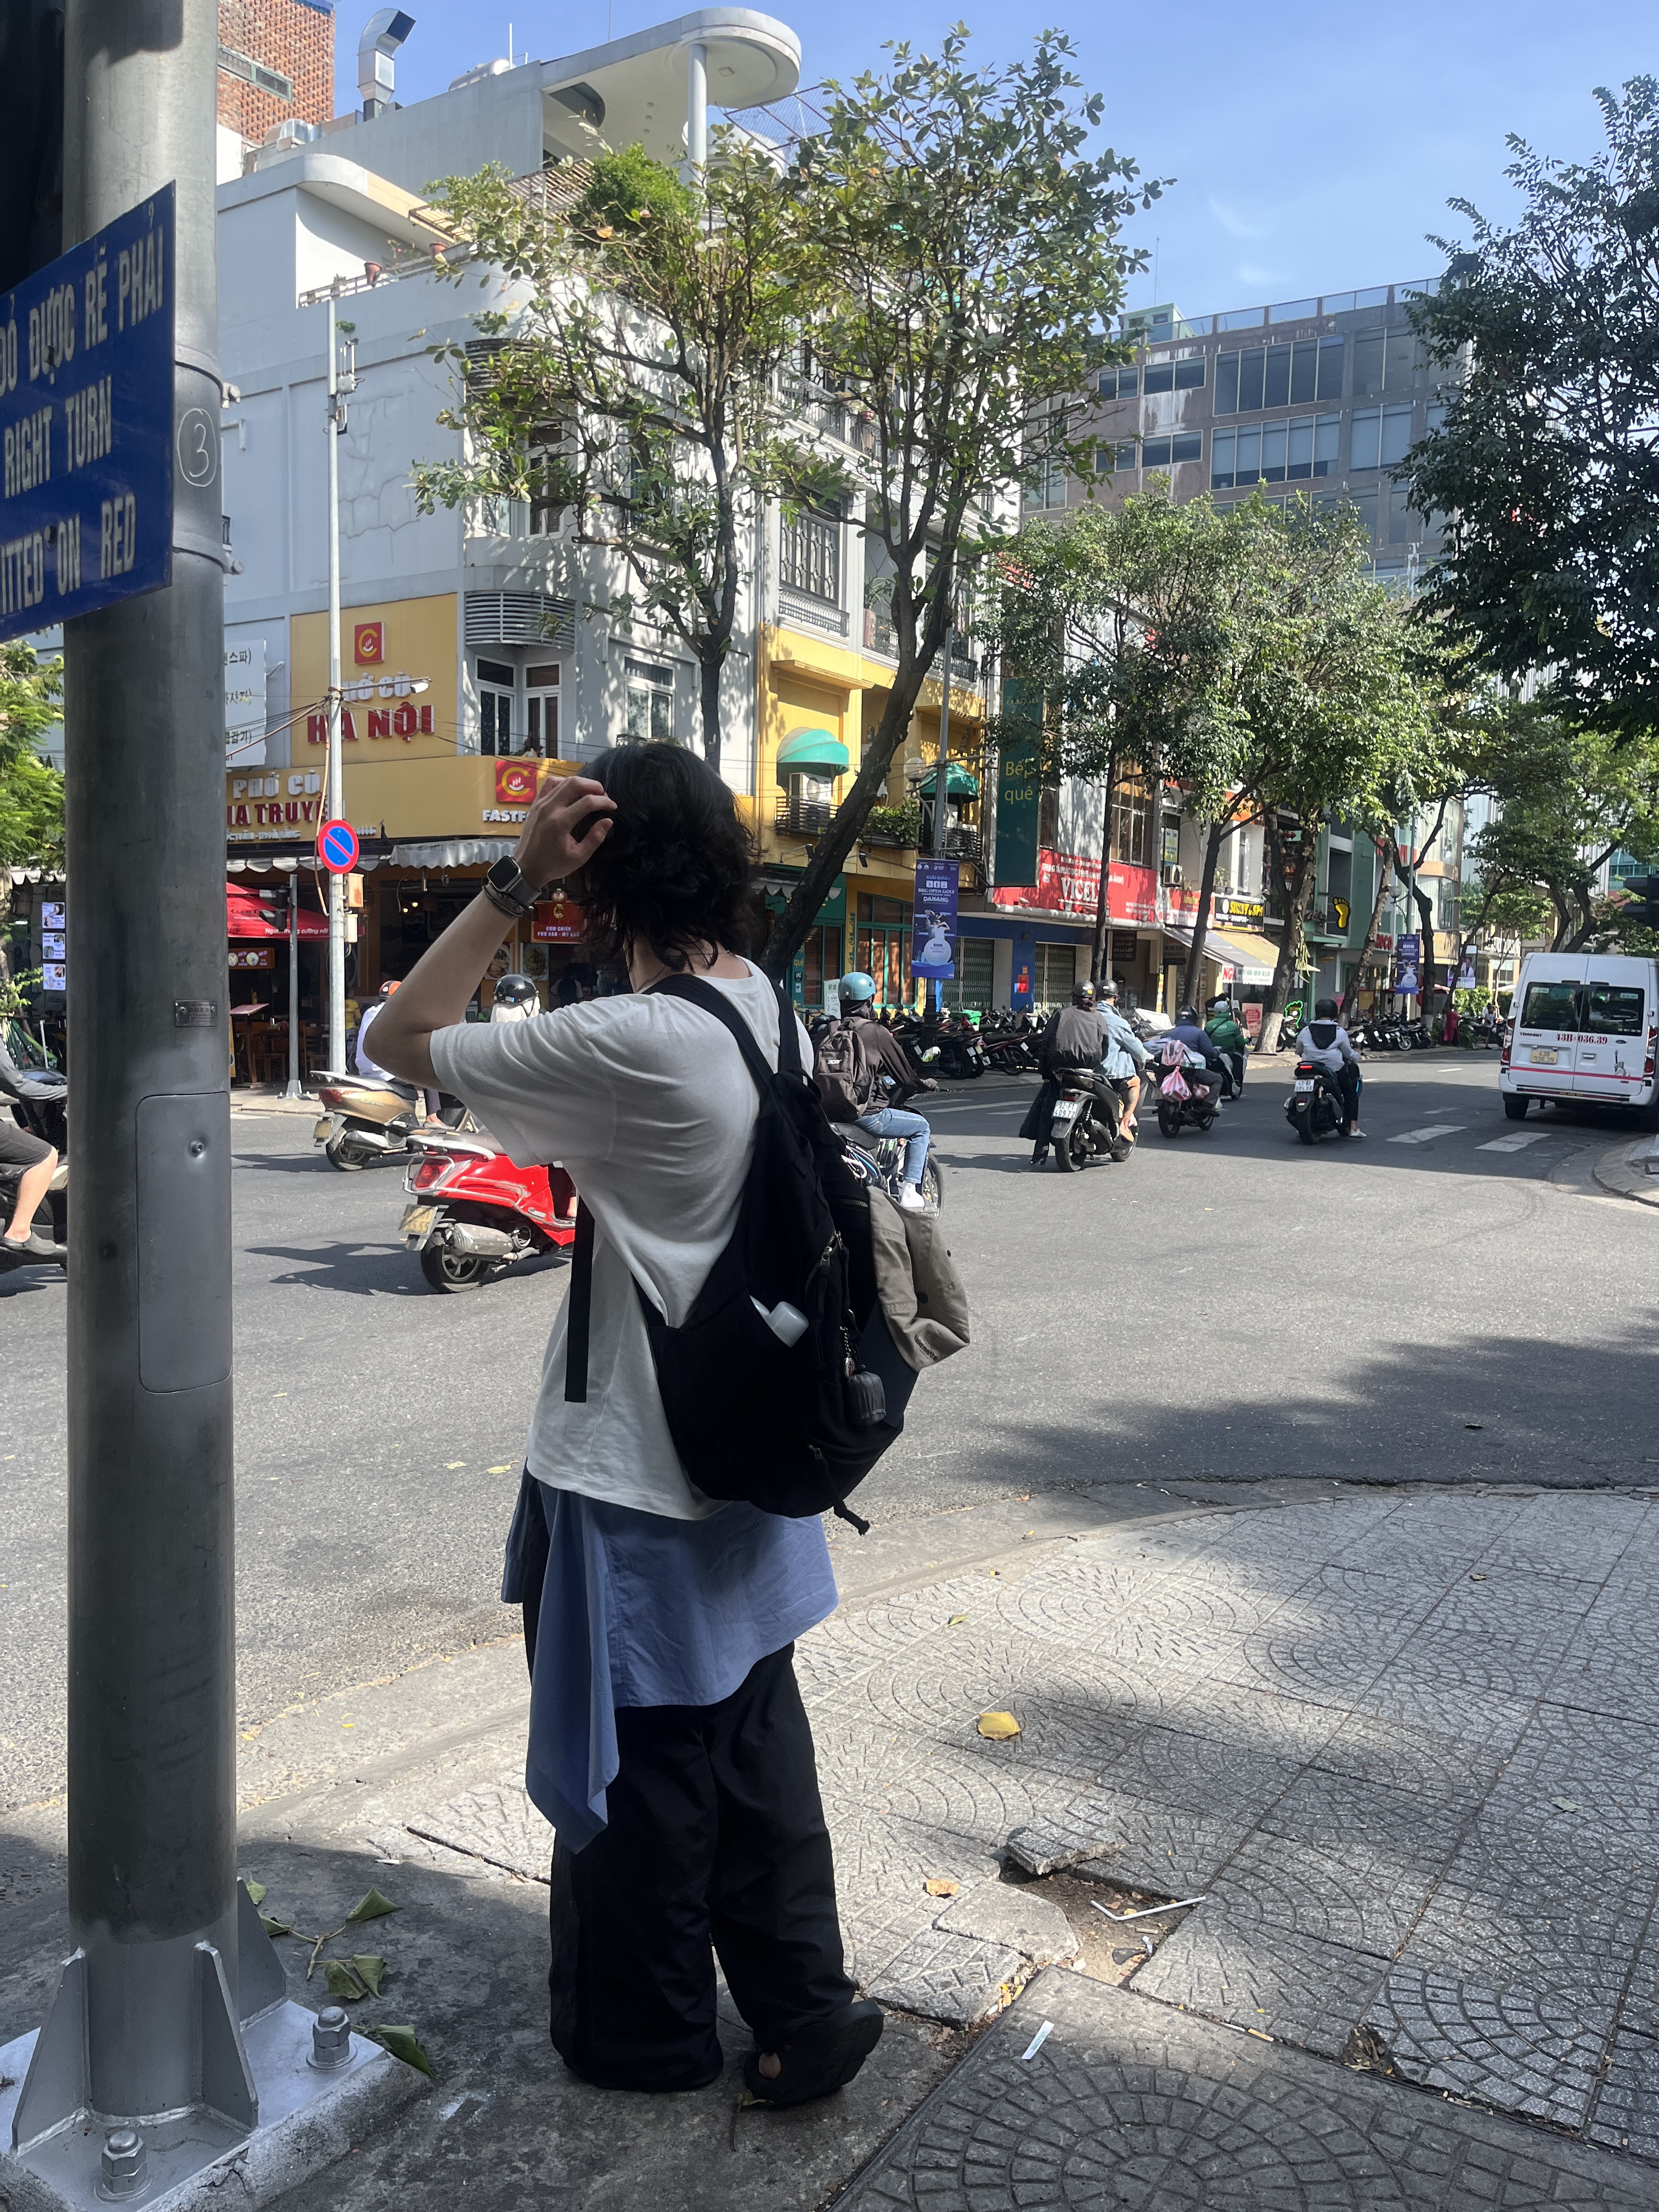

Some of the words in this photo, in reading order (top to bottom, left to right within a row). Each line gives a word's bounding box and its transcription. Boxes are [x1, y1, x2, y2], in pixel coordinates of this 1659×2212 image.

[30, 284, 75, 384] ĐƯỢC
[119, 201, 163, 332] PHẢI
[4, 405, 53, 499] RIGHT
[65, 375, 112, 472] TURN
[58, 513, 81, 596] ON
[101, 493, 136, 579] RED
[368, 701, 435, 742] NỘI
[1005, 786, 1033, 805] quê
[483, 809, 527, 822] FASTF
[1061, 876, 1099, 902] VICEL
[1222, 967, 1237, 981] NGA
[1556, 1032, 1573, 1042] 43B
[1578, 1035, 1608, 1045] 036.39
[1059, 1102, 1075, 1110] 92-F1
